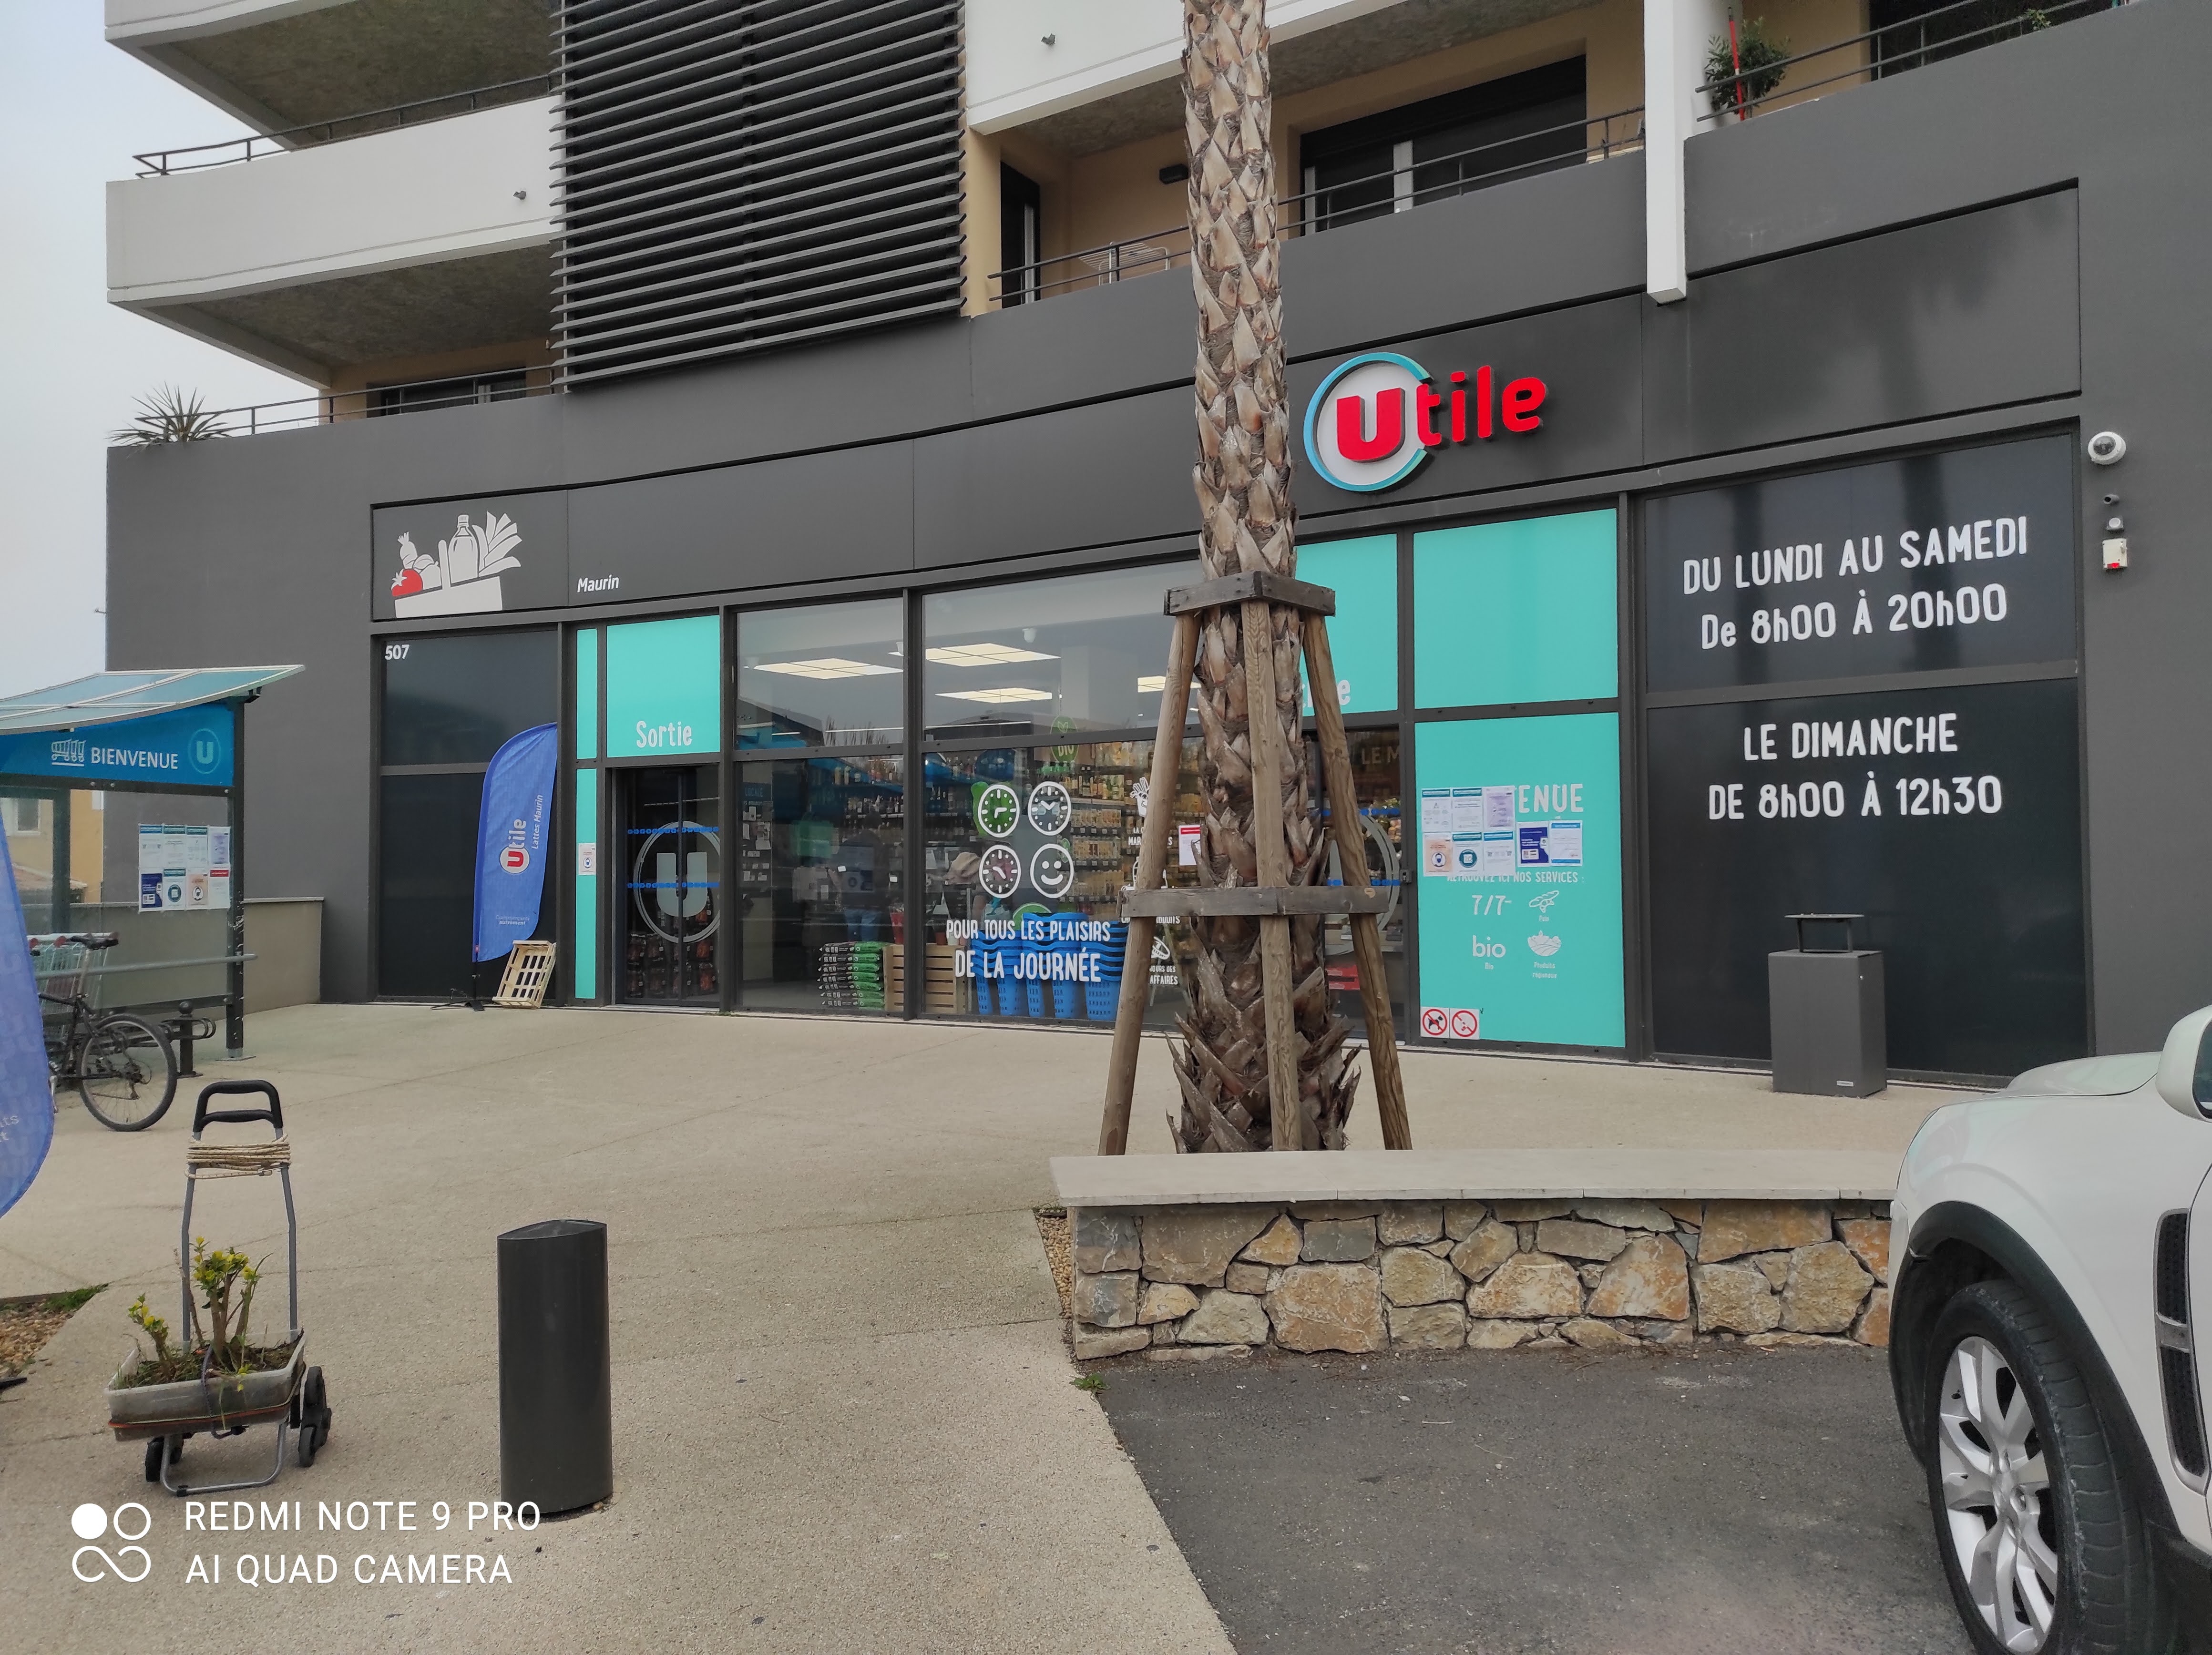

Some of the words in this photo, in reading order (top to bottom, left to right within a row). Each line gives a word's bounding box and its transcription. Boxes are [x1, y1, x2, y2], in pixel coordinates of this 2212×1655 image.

[1684, 556, 1721, 594] DU
[1735, 543, 1823, 588] LUNDI
[1839, 535, 1883, 576] AU
[1900, 516, 2027, 568] SAMEDI
[577, 575, 619, 593] Maurin
[1701, 614, 1736, 649] De
[1751, 602, 1836, 644] 8h00
[1853, 590, 1873, 635] À
[1888, 583, 2007, 632] 20h00
[385, 644, 410, 660] 507
[636, 720, 692, 748] Sortie
[1744, 723, 1778, 761] LE
[1792, 713, 1958, 759] DIMANCHE
[91, 747, 178, 769] BIENVENUE
[196, 741, 214, 764] U
[1709, 783, 1744, 820] DE
[1758, 781, 1844, 818] 8h00
[1861, 771, 1882, 817] À
[1895, 775, 2002, 816] 12h30
[533, 795, 543, 822] Maurin
[531, 824, 540, 849] Lattes
[656, 852, 707, 917] U
[1514, 872, 1532, 883] NOS
[1536, 872, 1578, 883] SERVICES
[946, 919, 978, 940] POUR
[984, 919, 1015, 940] TOUS
[1021, 920, 1045, 941] LES
[1050, 921, 1111, 942] PLAISIRS
[1472, 935, 1506, 958] bio
[955, 950, 976, 978] DE
[983, 951, 1004, 979] LA
[1014, 947, 1101, 982] JOURNÉE
[1149, 975, 1178, 985] AFFAIRES
